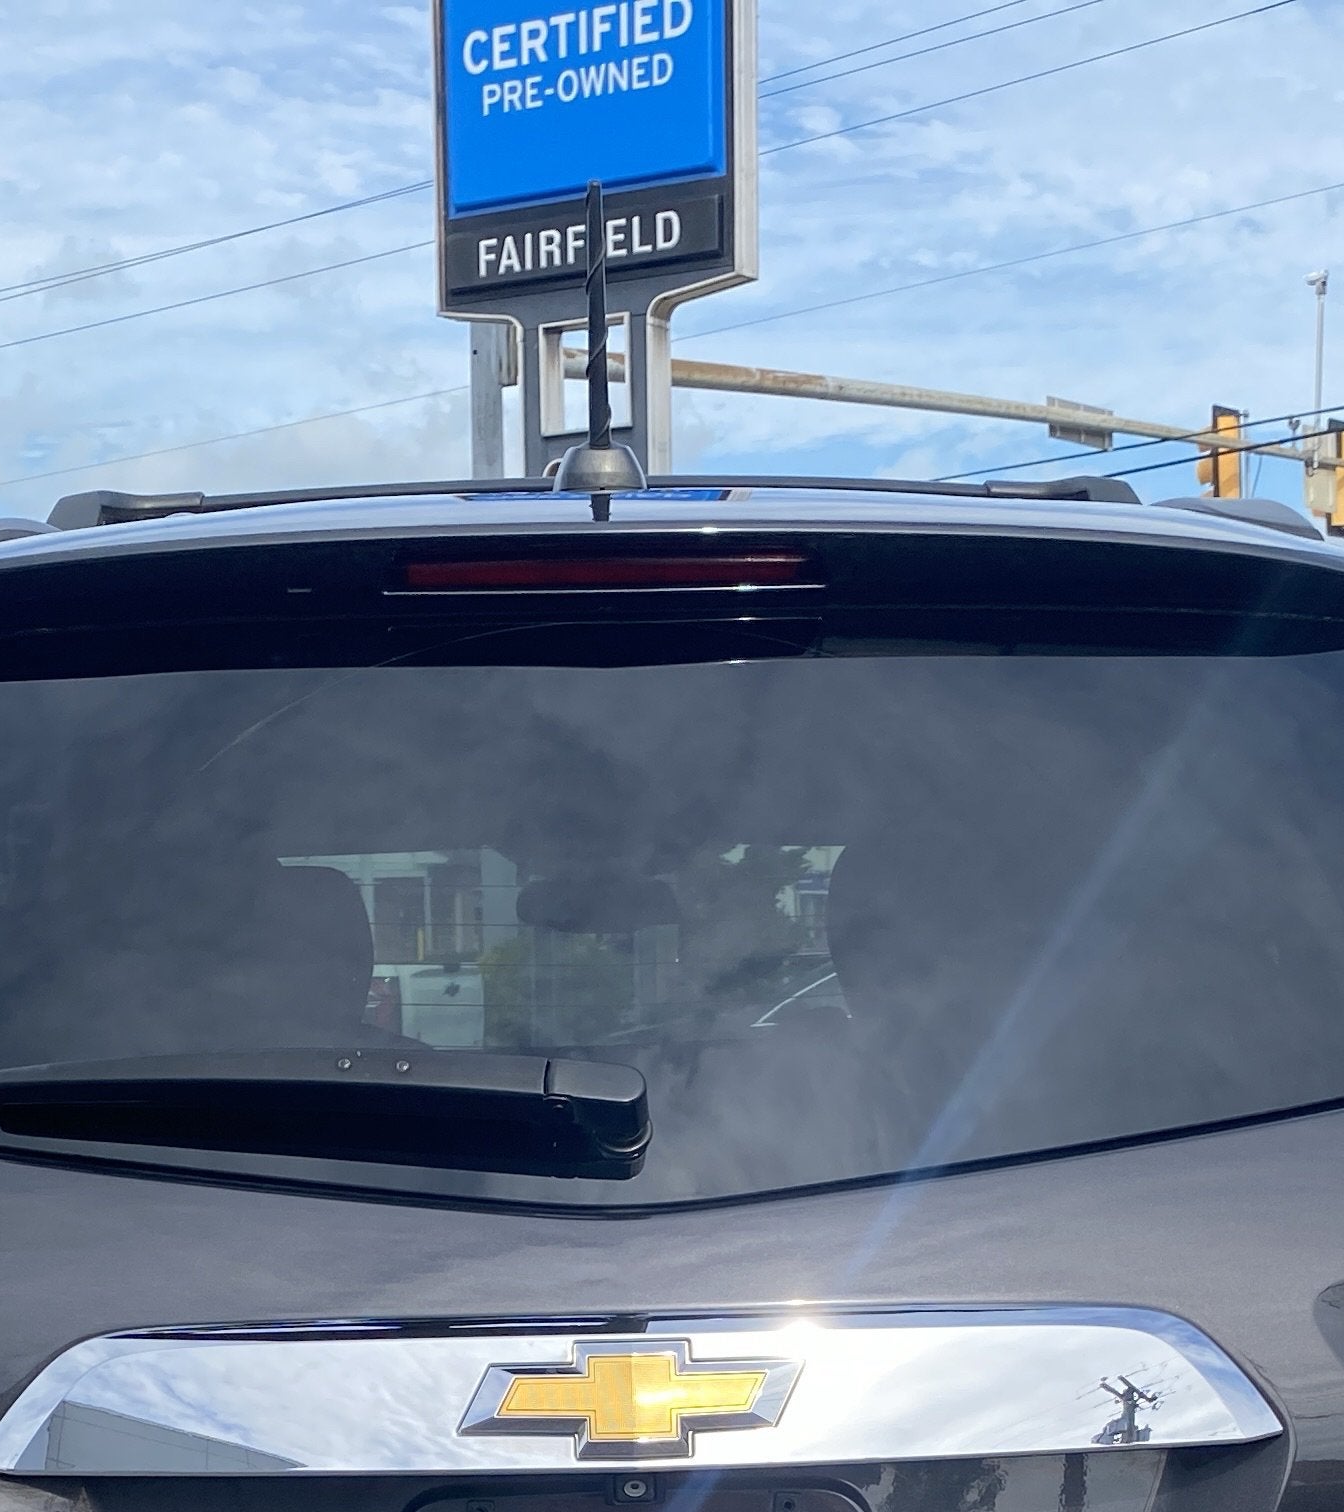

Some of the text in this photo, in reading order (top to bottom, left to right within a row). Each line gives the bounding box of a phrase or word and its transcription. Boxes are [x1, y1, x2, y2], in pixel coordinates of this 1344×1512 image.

[462, 0, 694, 75] CERTIFIED
[482, 52, 674, 116] PRE-OWNED
[478, 210, 682, 278] FAIRFELD
